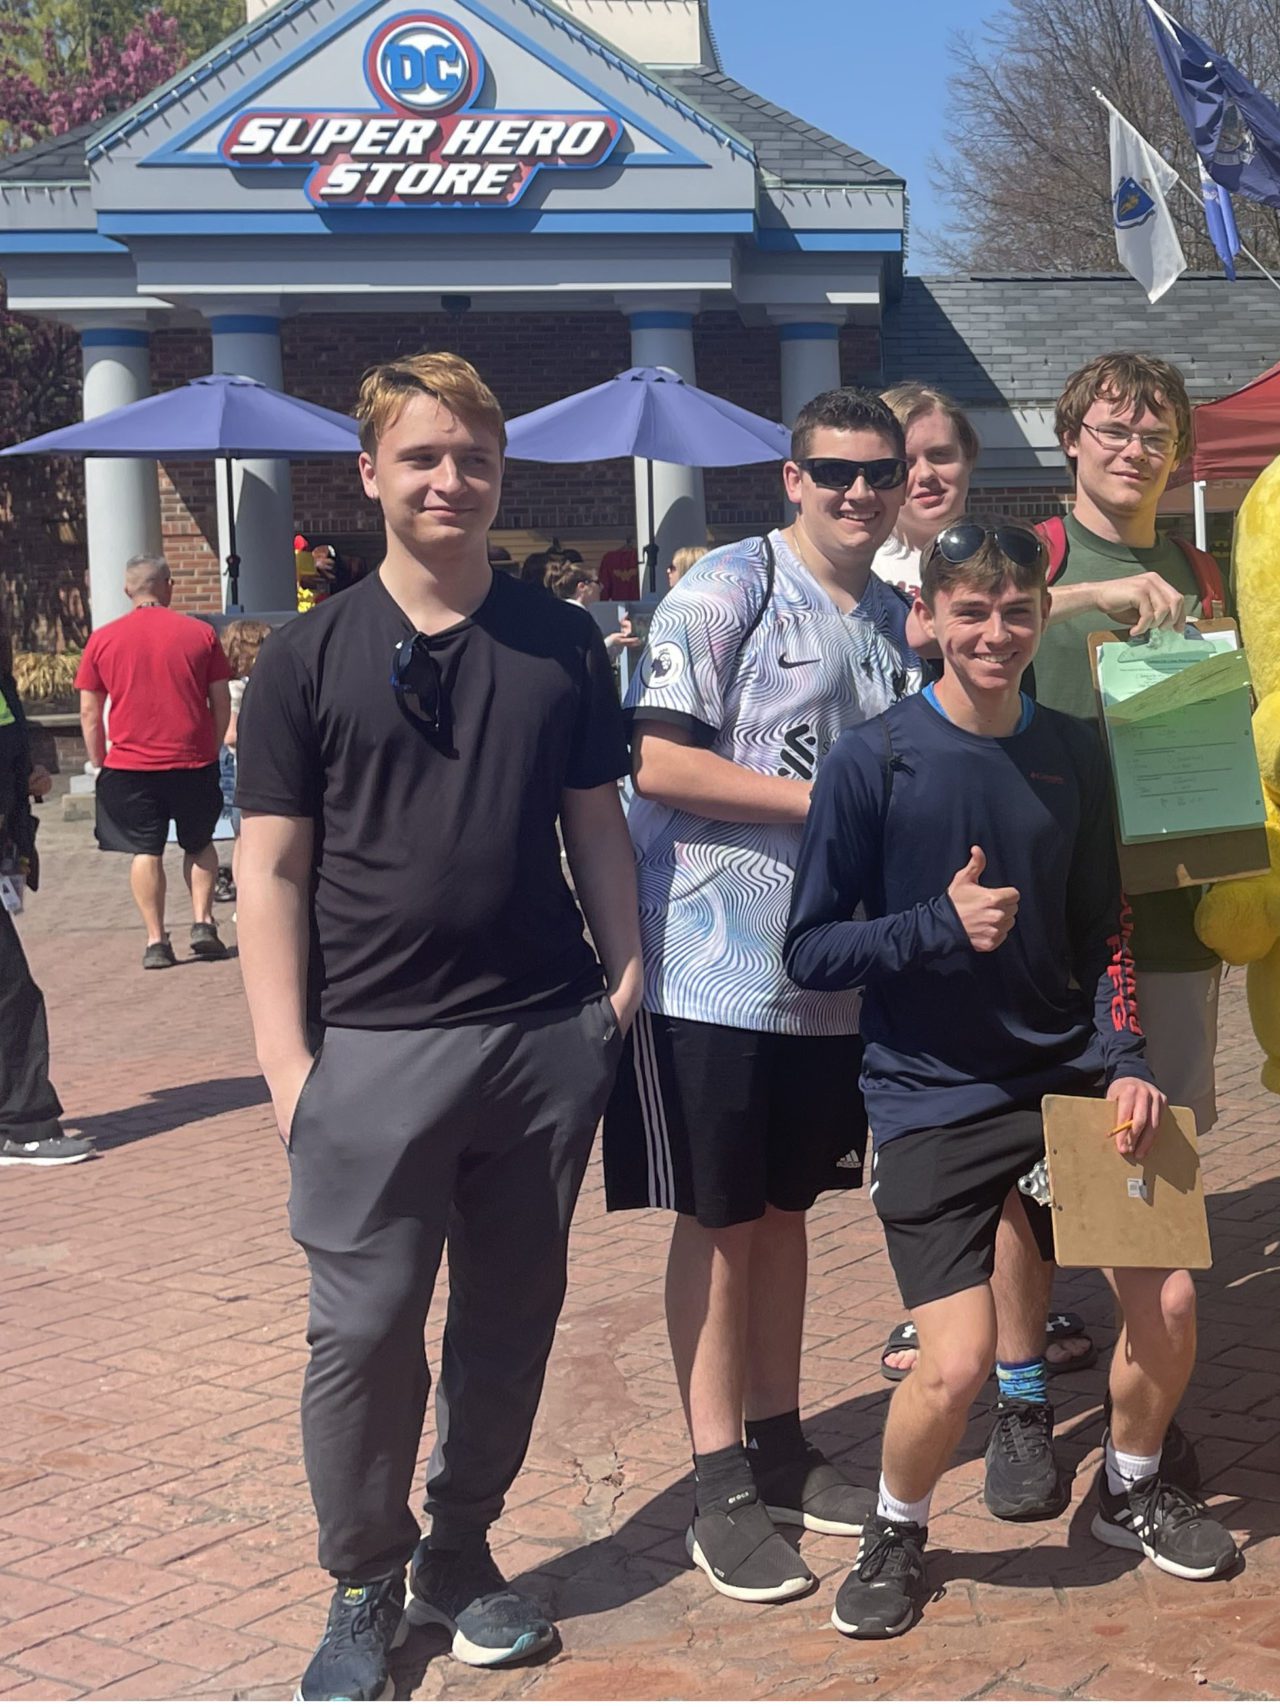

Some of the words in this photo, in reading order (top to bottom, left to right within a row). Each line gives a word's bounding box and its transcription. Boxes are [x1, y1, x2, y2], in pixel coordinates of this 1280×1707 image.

[384, 43, 460, 90] DC
[230, 117, 439, 156] SUPER
[440, 118, 606, 156] HERO
[319, 162, 520, 196] STORE
